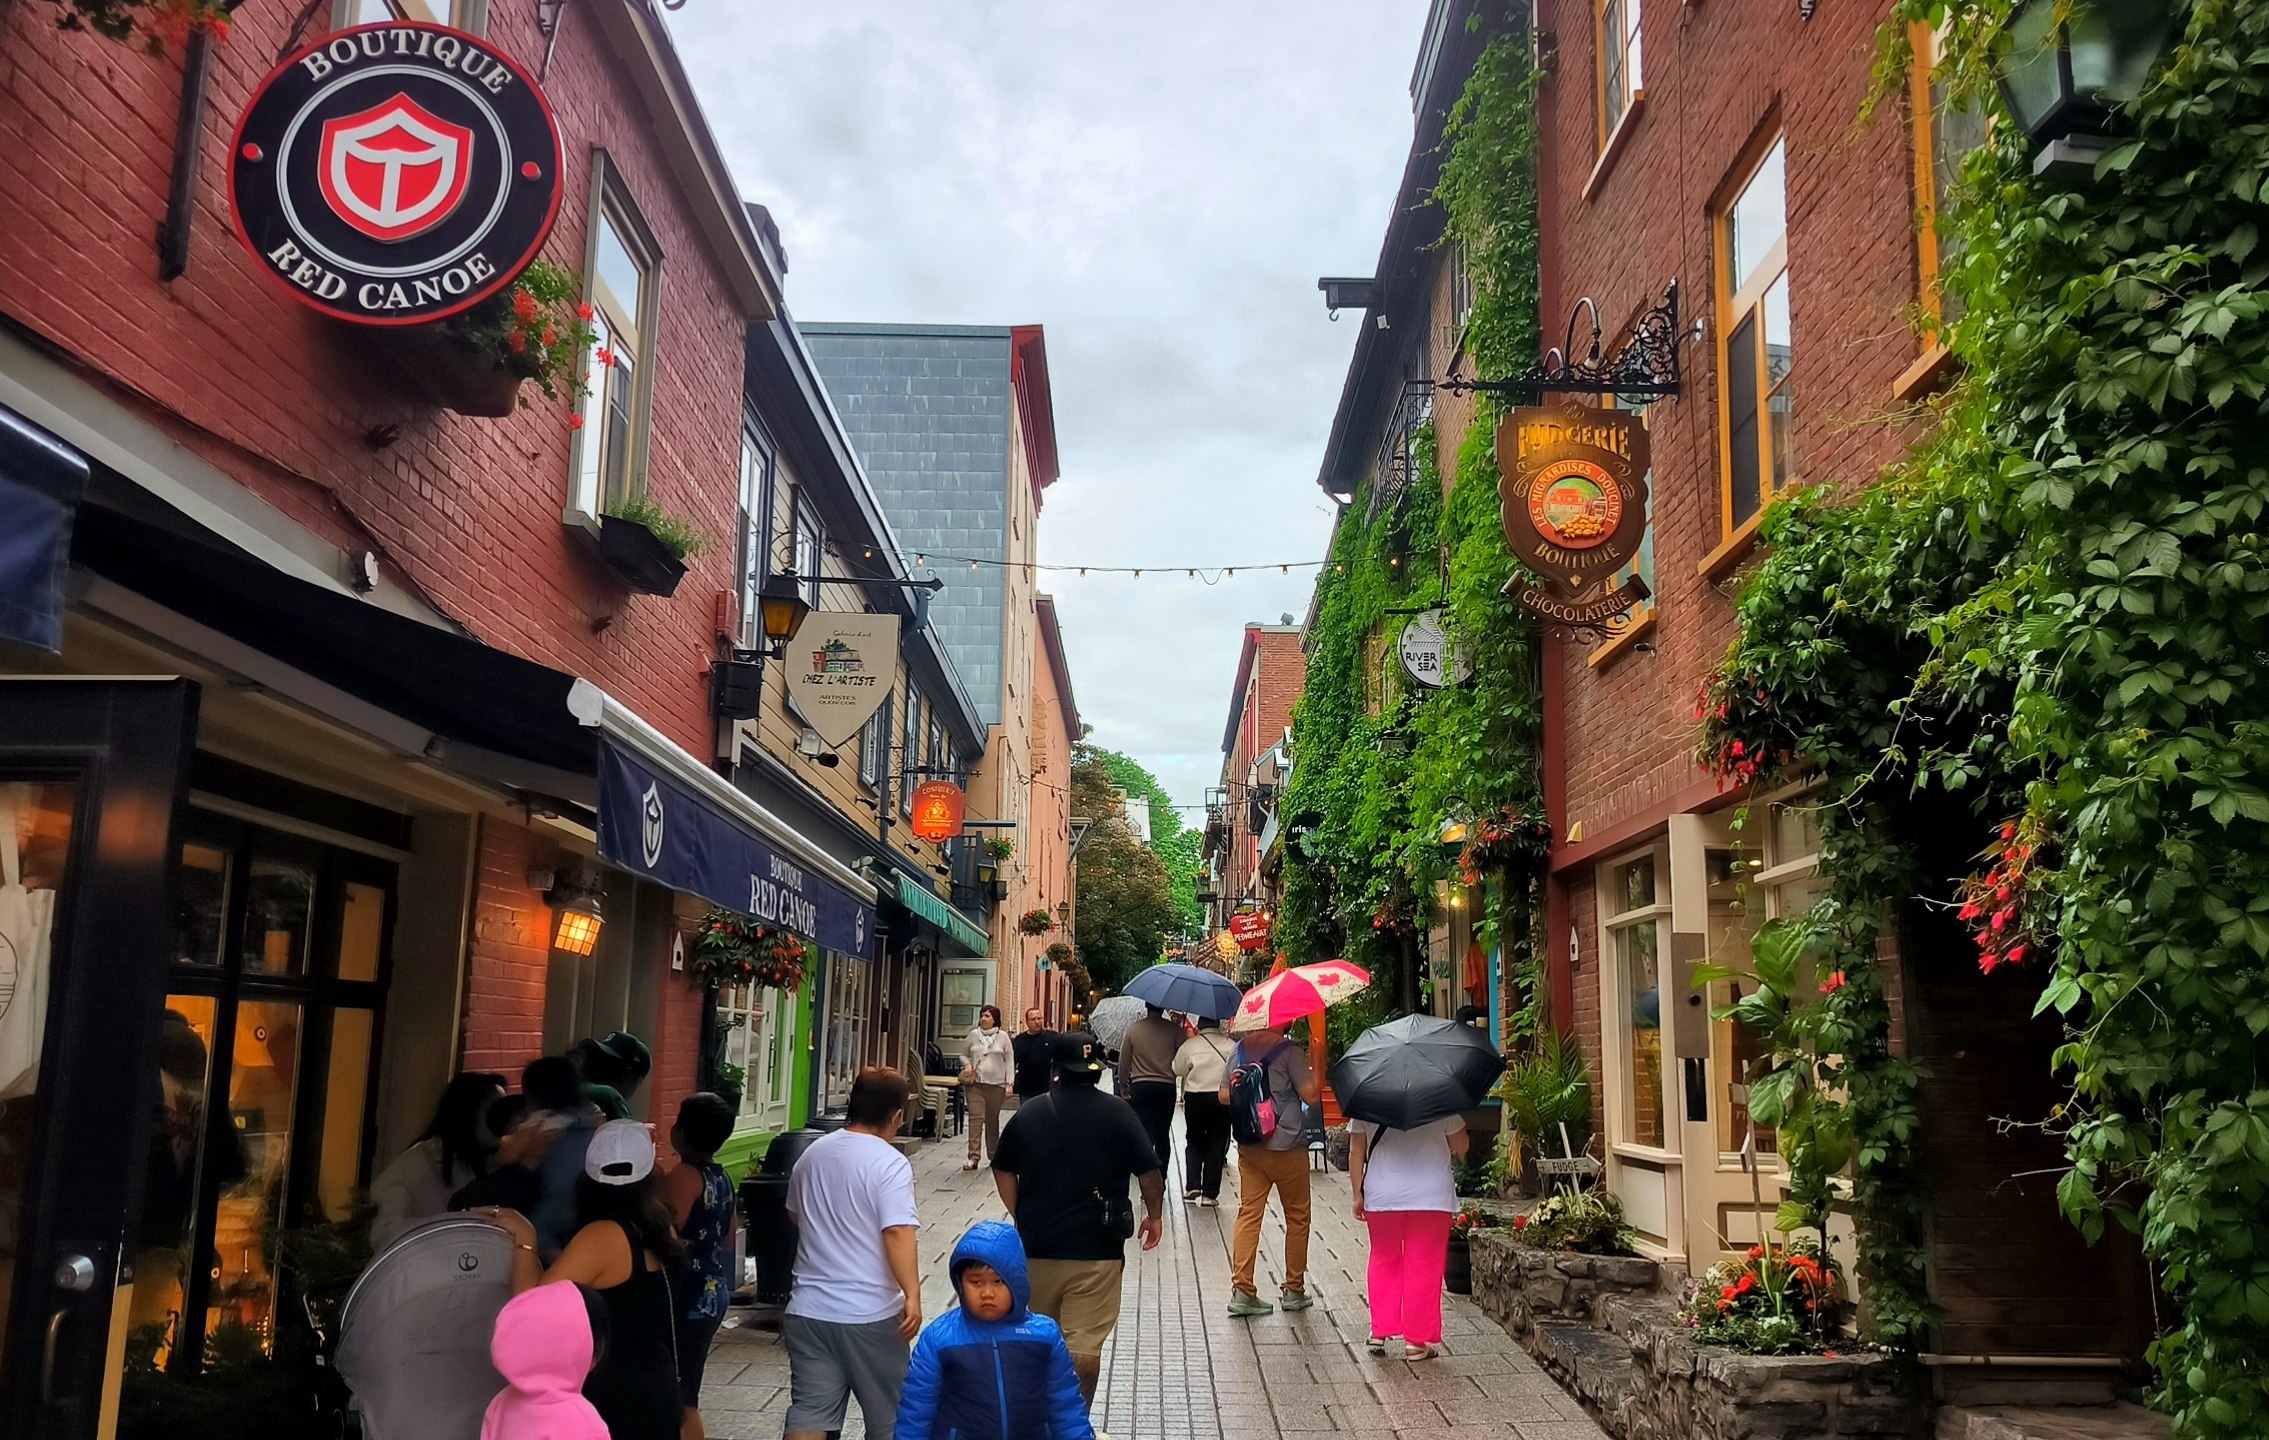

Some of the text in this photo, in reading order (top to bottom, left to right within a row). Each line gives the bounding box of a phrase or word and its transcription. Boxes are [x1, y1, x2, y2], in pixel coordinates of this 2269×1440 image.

[299, 29, 513, 95] BOUTIQUE
[267, 238, 496, 310] RED CANOE
[1531, 462, 1620, 527] LES MIGNARDISES DOUCINET
[1533, 541, 1620, 570] BOUTIQUE
[1522, 589, 1631, 622] CHOCOLATERIE
[1405, 652, 1438, 662] RIVER
[1417, 662, 1438, 672] SEA
[802, 673, 877, 687] CHEZ L'ARTISTE
[769, 853, 803, 892] BOUTIQUE
[749, 873, 816, 938] RED CANOE
[1552, 1161, 1580, 1172] FUDGE
